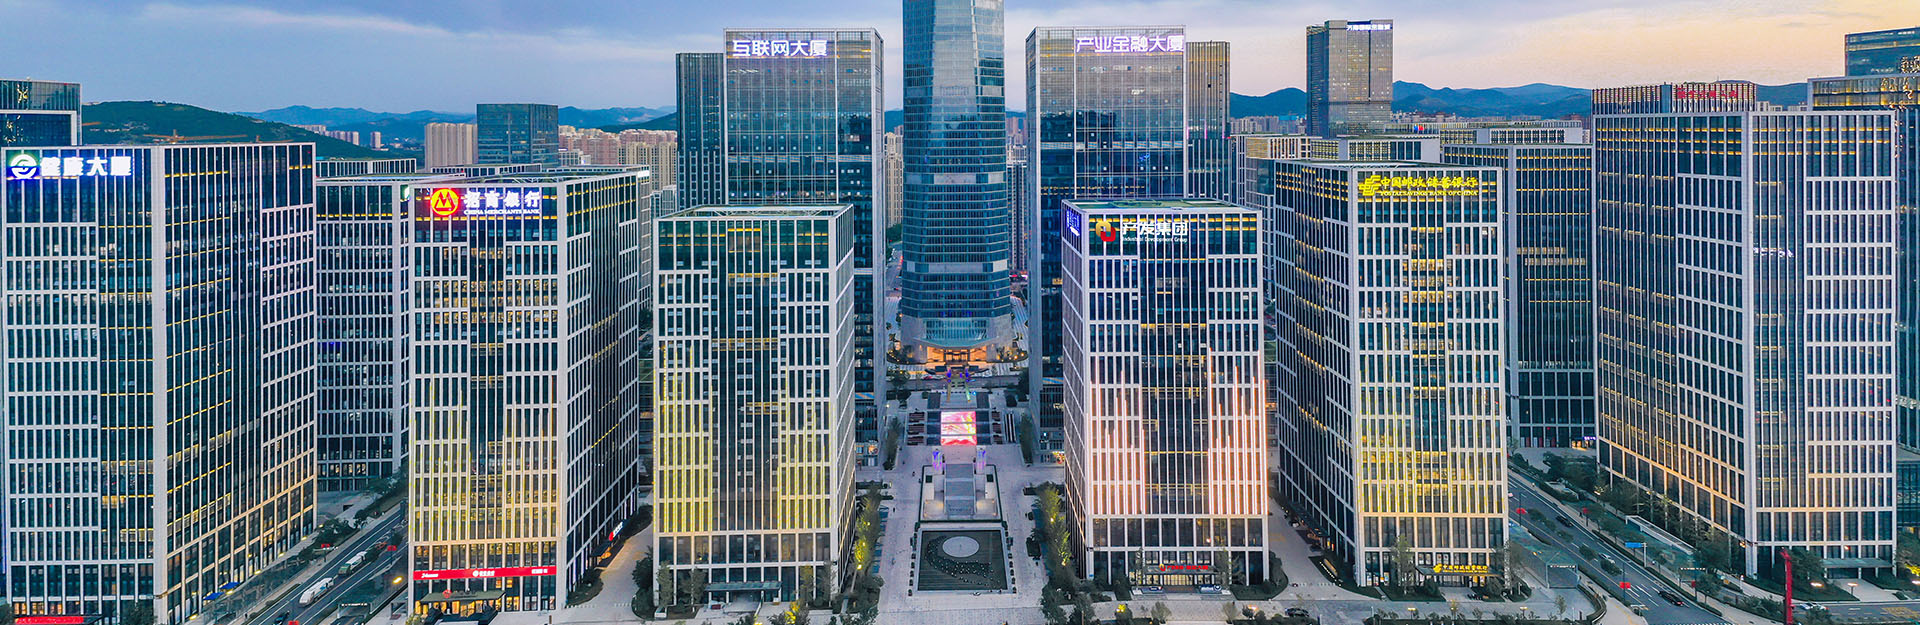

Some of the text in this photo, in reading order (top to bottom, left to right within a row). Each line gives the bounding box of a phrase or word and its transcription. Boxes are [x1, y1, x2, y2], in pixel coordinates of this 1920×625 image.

[732, 39, 828, 57] 互联网大厦
[1076, 35, 1184, 53] 产业金融大厦
[1380, 176, 1479, 189] 中国邮政储蓄银行
[463, 190, 541, 208] 招商银行
[1122, 221, 1188, 236] 产发集团
